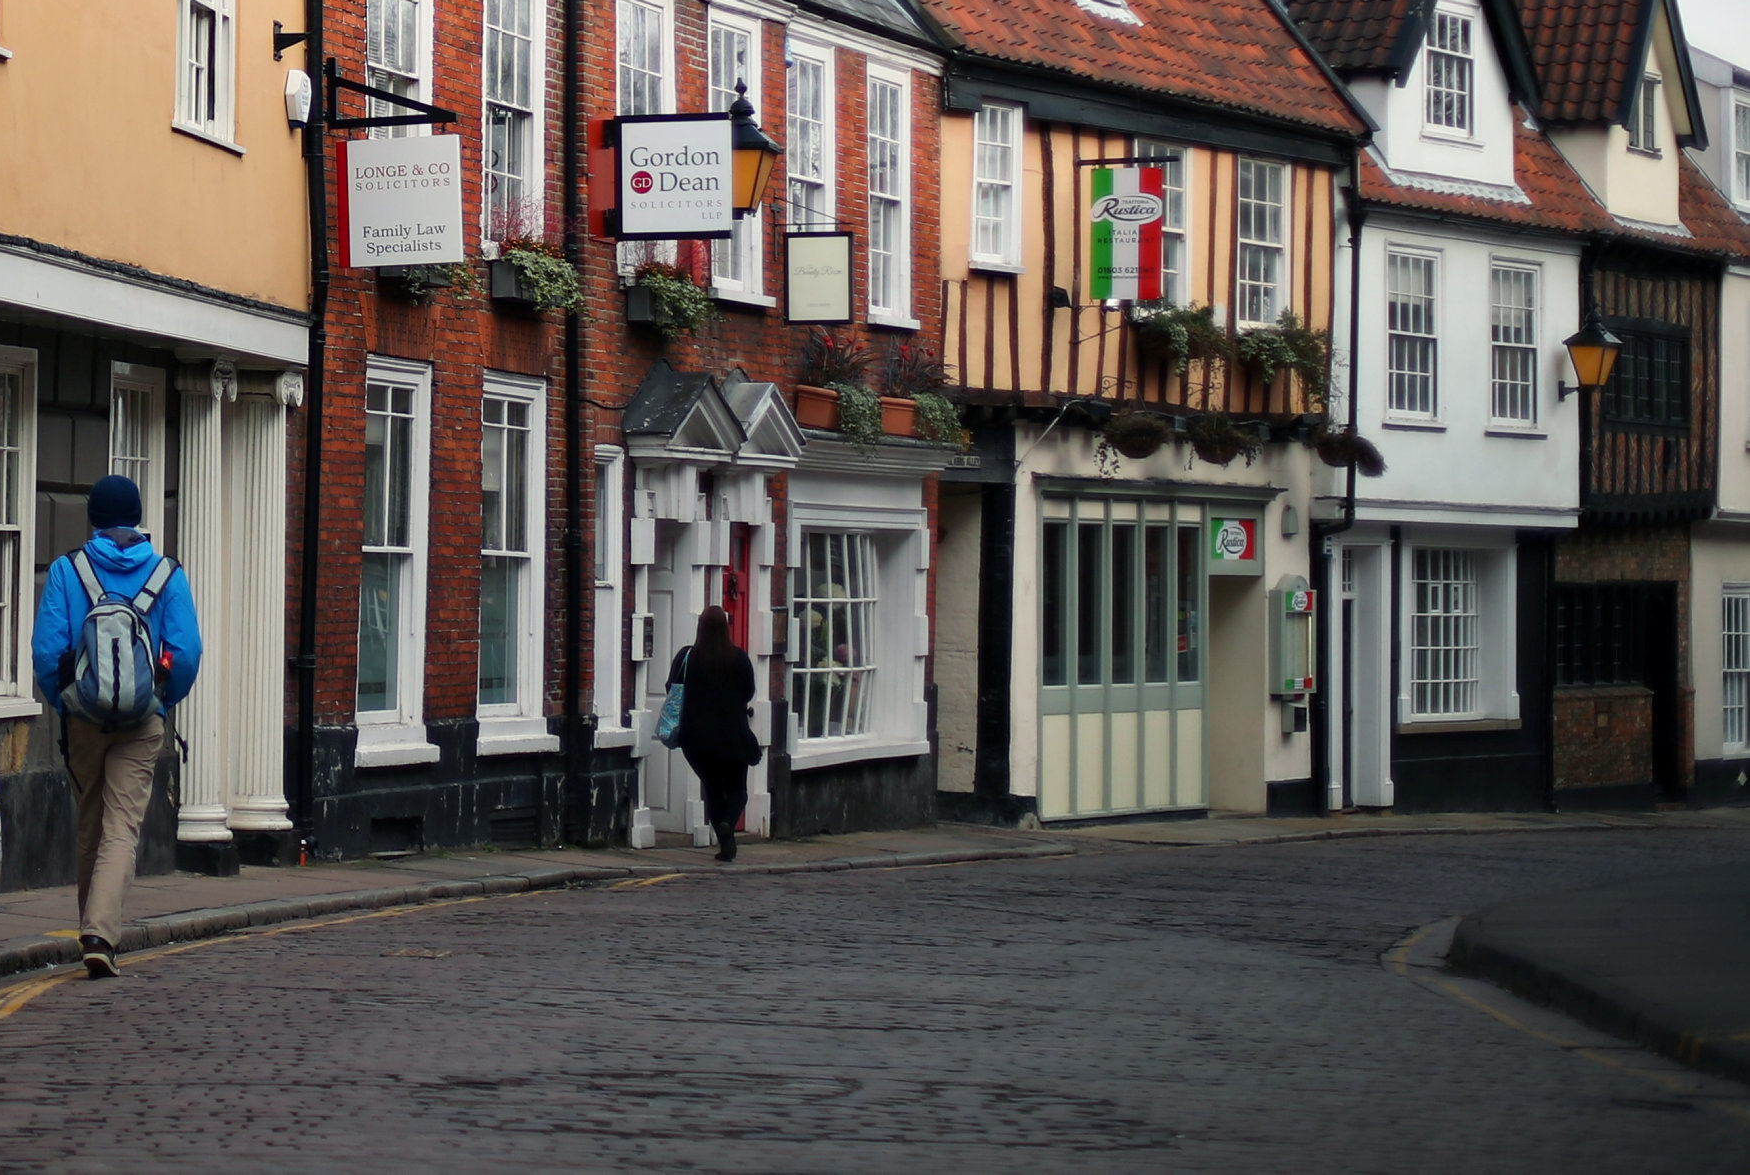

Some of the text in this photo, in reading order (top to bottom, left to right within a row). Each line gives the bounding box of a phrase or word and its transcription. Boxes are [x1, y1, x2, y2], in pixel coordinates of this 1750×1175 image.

[630, 145, 721, 167] Gordon
[355, 162, 450, 179] LONGE & CO
[355, 177, 451, 191] SOLICITORS
[632, 172, 720, 192] GD Dean
[630, 199, 722, 209] SOLICITORS
[1094, 197, 1156, 219] Rustica
[363, 223, 446, 239] Family Law
[366, 239, 442, 256] Specialists
